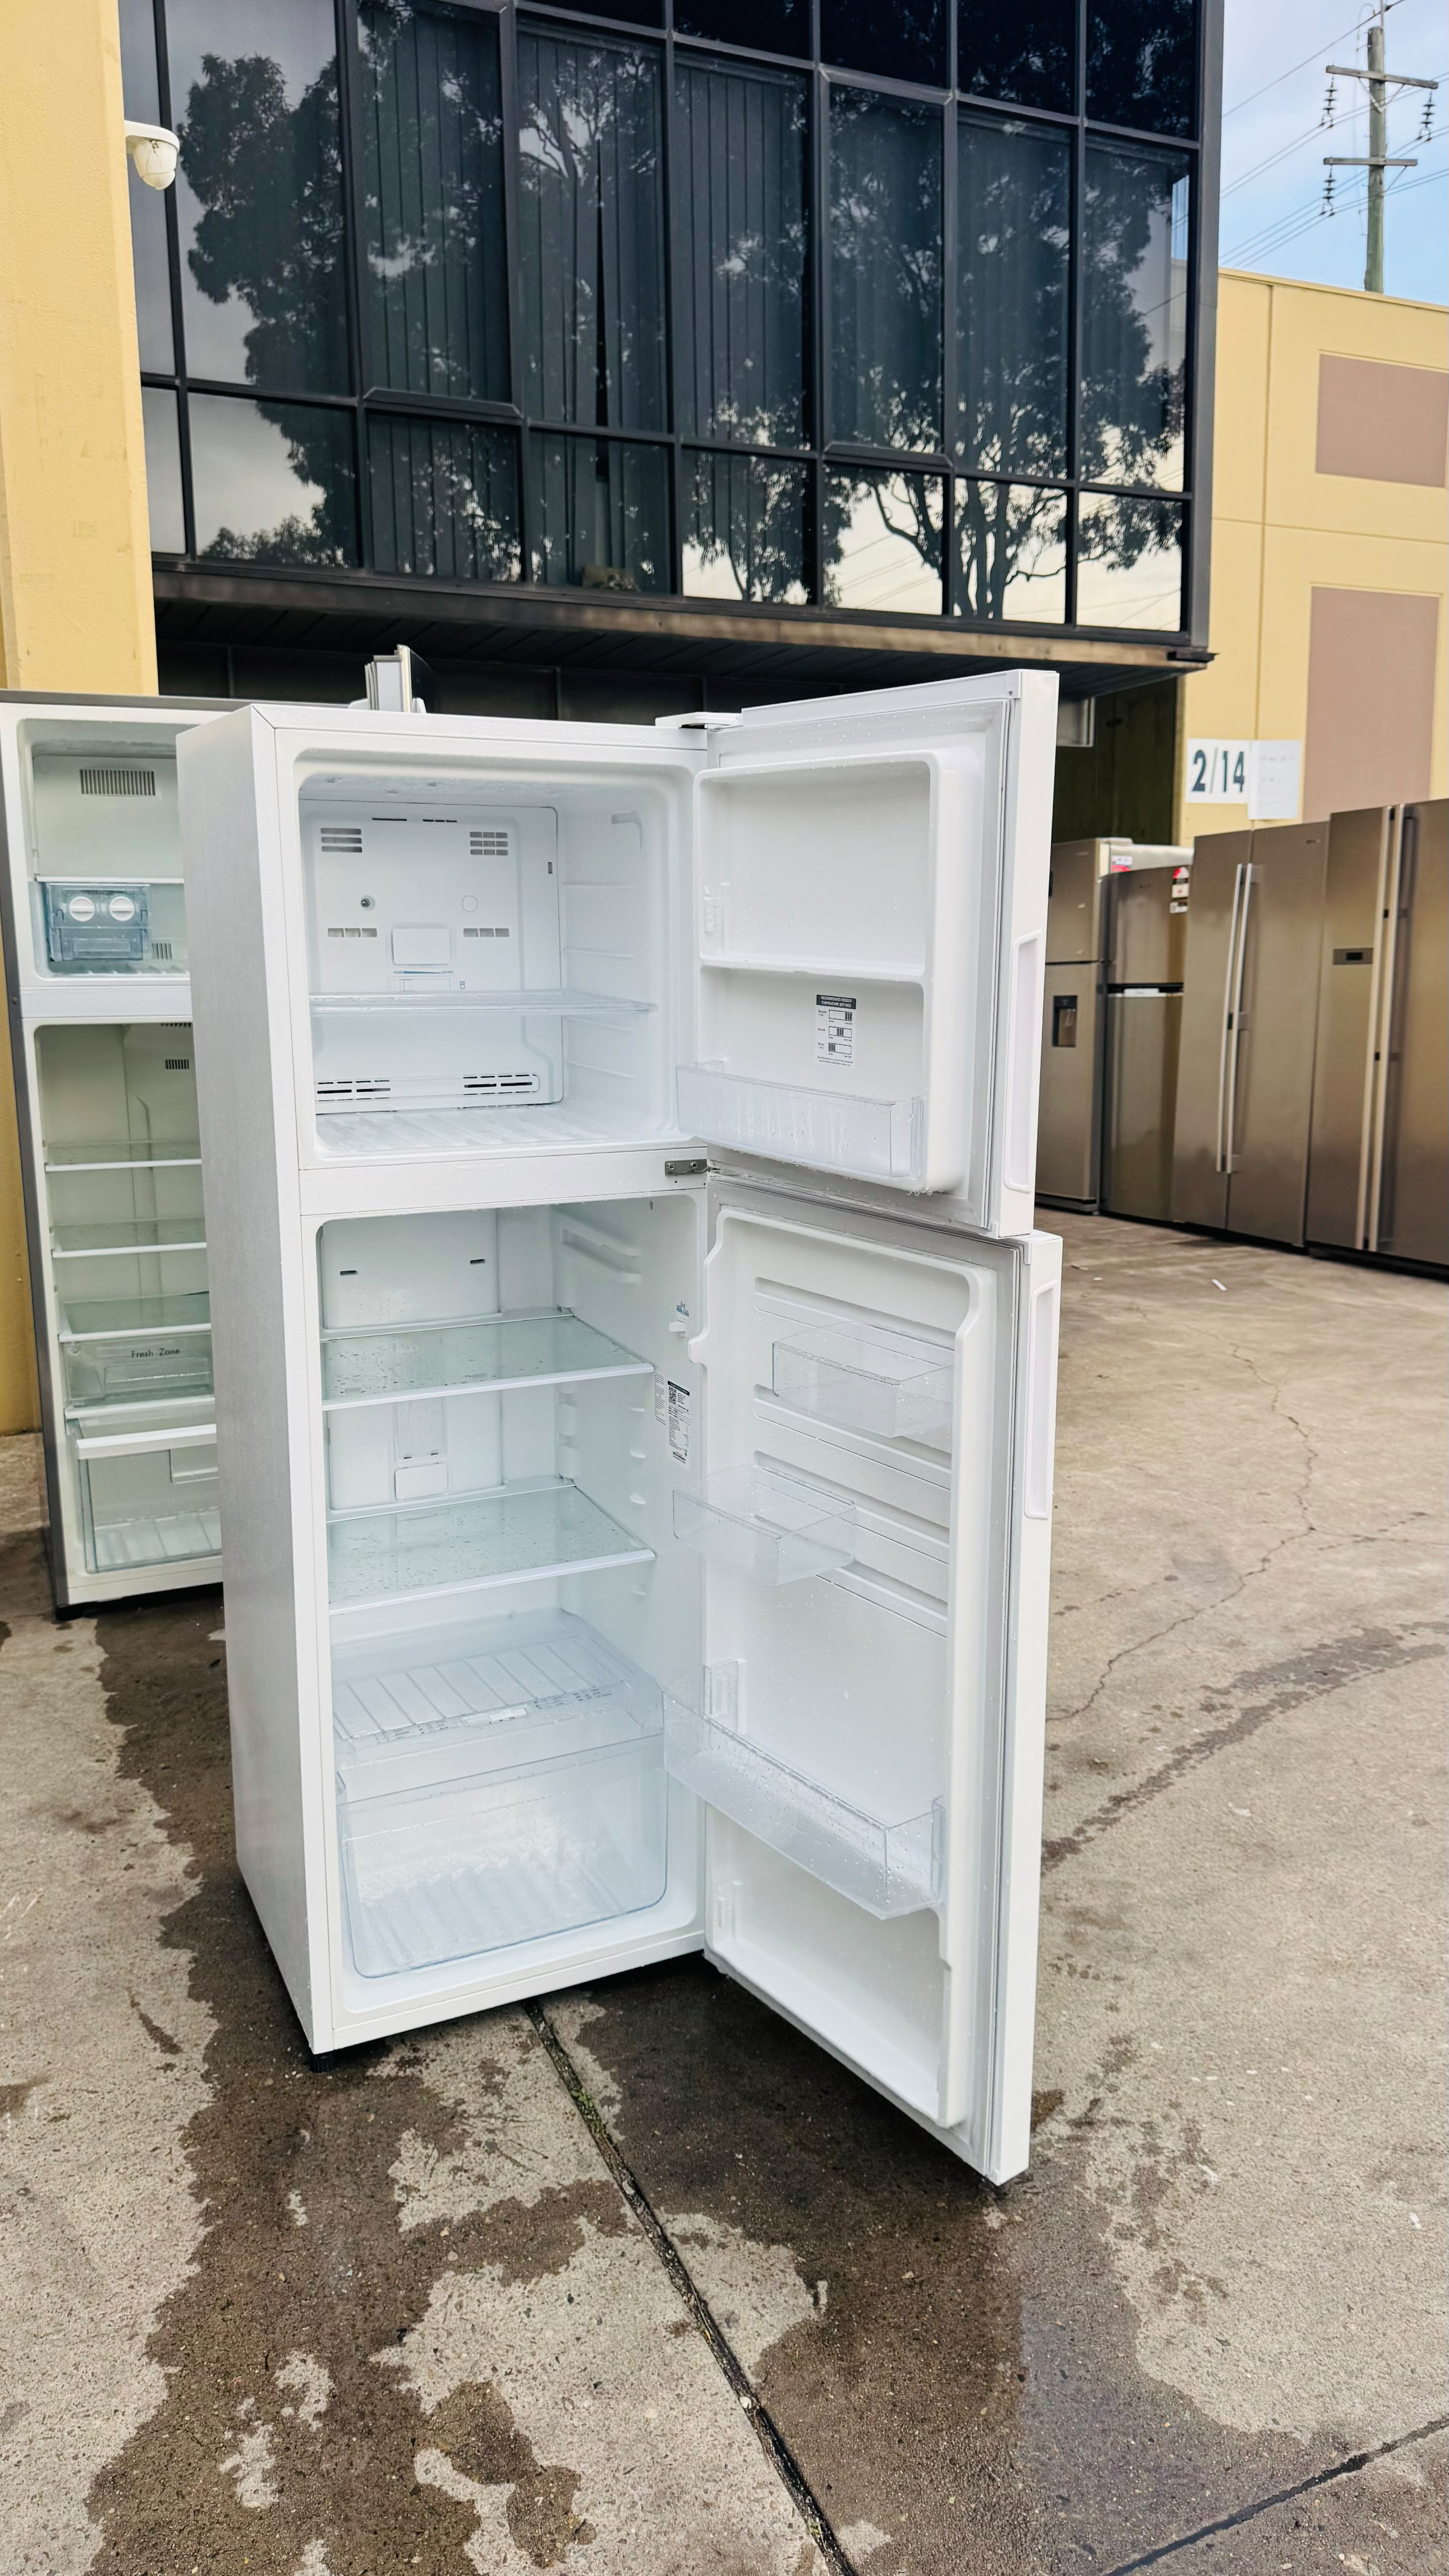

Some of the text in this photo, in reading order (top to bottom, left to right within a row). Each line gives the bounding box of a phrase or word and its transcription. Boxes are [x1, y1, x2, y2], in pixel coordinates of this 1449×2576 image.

[1192, 748, 1245, 794] 2/14
[131, 1348, 180, 1358] Fresh Zone
